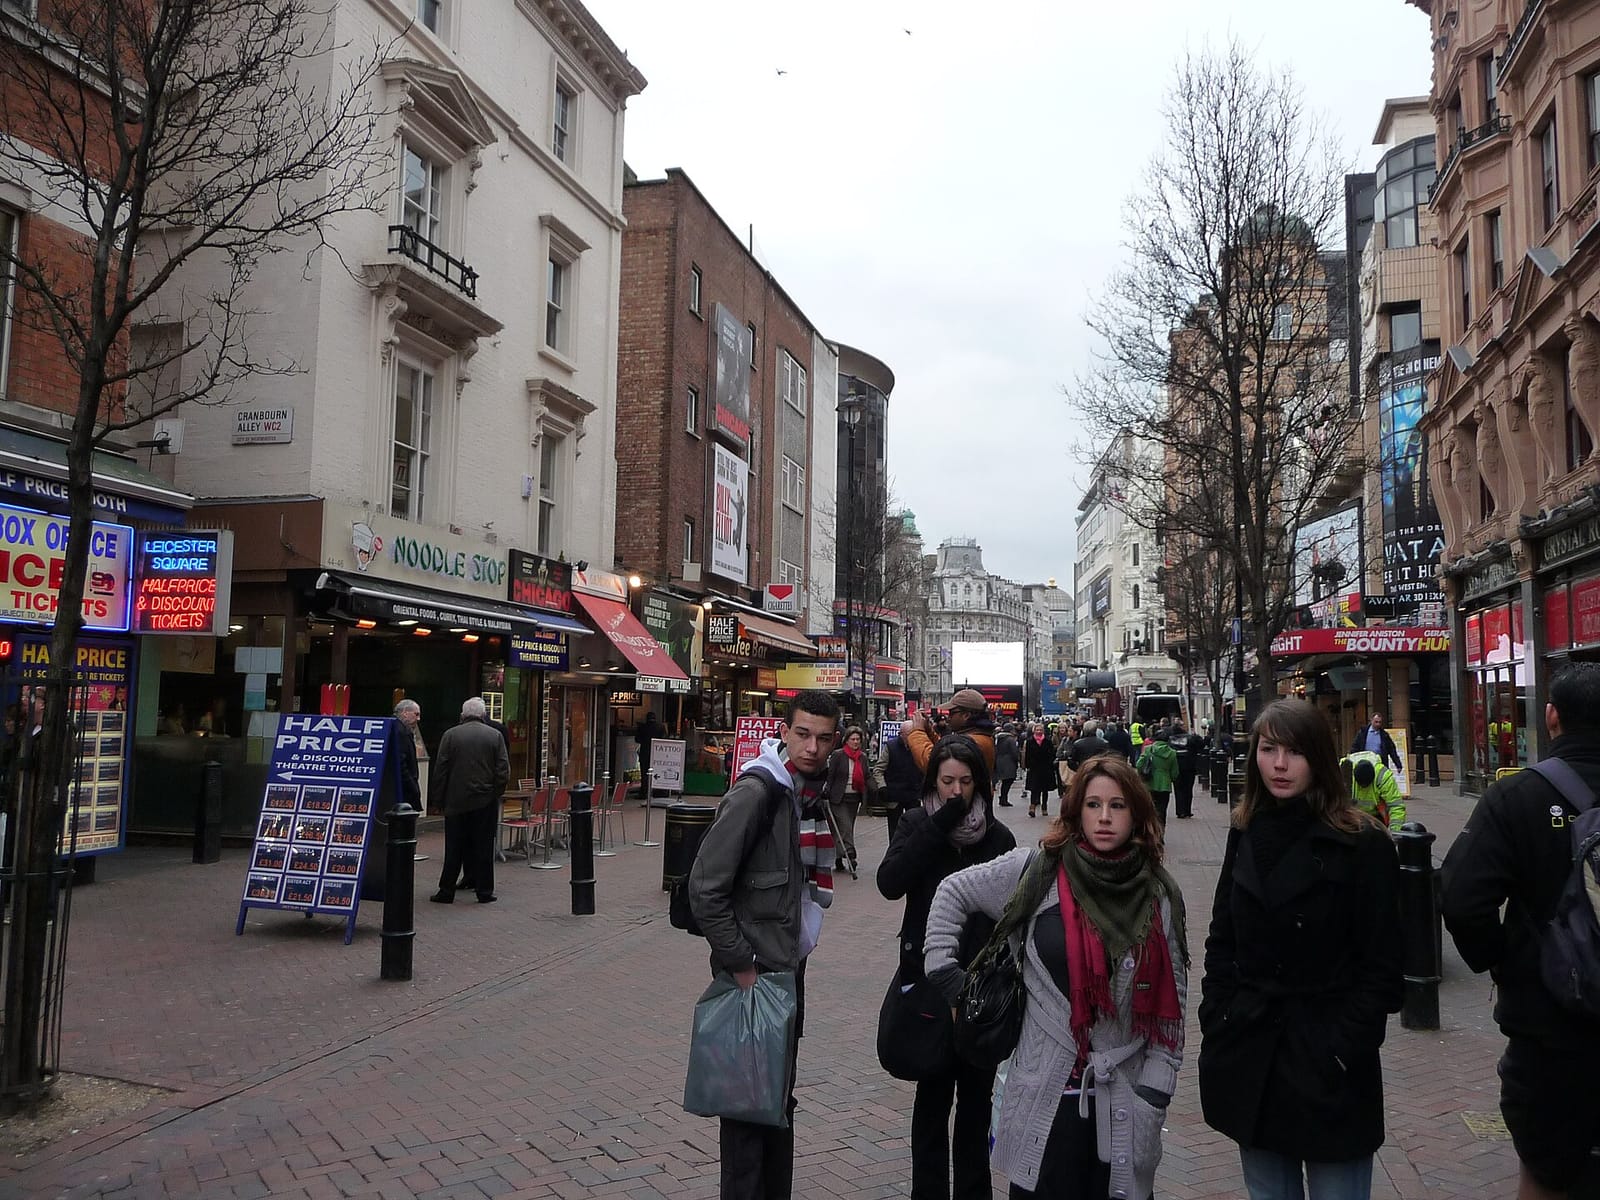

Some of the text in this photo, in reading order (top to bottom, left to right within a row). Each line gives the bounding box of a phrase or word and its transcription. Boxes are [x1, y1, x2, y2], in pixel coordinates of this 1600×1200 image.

[237, 410, 288, 421] CRANBOURN
[237, 421, 282, 432] ALLEY WC2
[0, 472, 69, 499] LF PRICE
[45, 521, 118, 559] OFCE
[145, 539, 217, 553] LEICESTER
[152, 557, 209, 571] SQUARE
[393, 535, 466, 578] NOODLE
[471, 553, 506, 585] STOP
[513, 577, 571, 611] CHICAGO
[10, 590, 107, 617] TICTS
[136, 596, 215, 611] & DISCOUNT
[392, 604, 419, 617] ORIENTAL
[27, 611, 35, 619] TO
[150, 612, 205, 629] TICKETS
[709, 617, 734, 627] HALF
[709, 626, 734, 635] PRICE
[1334, 630, 1368, 638] JENNIFER
[511, 639, 524, 649] HALF
[524, 640, 539, 651] PRICE
[543, 642, 567, 654] DISCOUNT
[751, 640, 768, 659] Bar
[1333, 638, 1347, 646] THE
[1346, 637, 1418, 651] BOUNTY
[21, 643, 50, 664] HA
[76, 647, 126, 669] PRICE
[519, 652, 560, 664] THEATRE TICKETS
[98, 672, 125, 682] TICKETS
[618, 692, 640, 700] PRICE
[284, 716, 384, 734] HALF
[738, 730, 779, 739] PRIC
[276, 735, 384, 753] PRICE
[655, 744, 681, 753] TATTOO
[302, 754, 364, 764] DISCOUNT
[275, 761, 377, 774] THEATRE TICKETS
